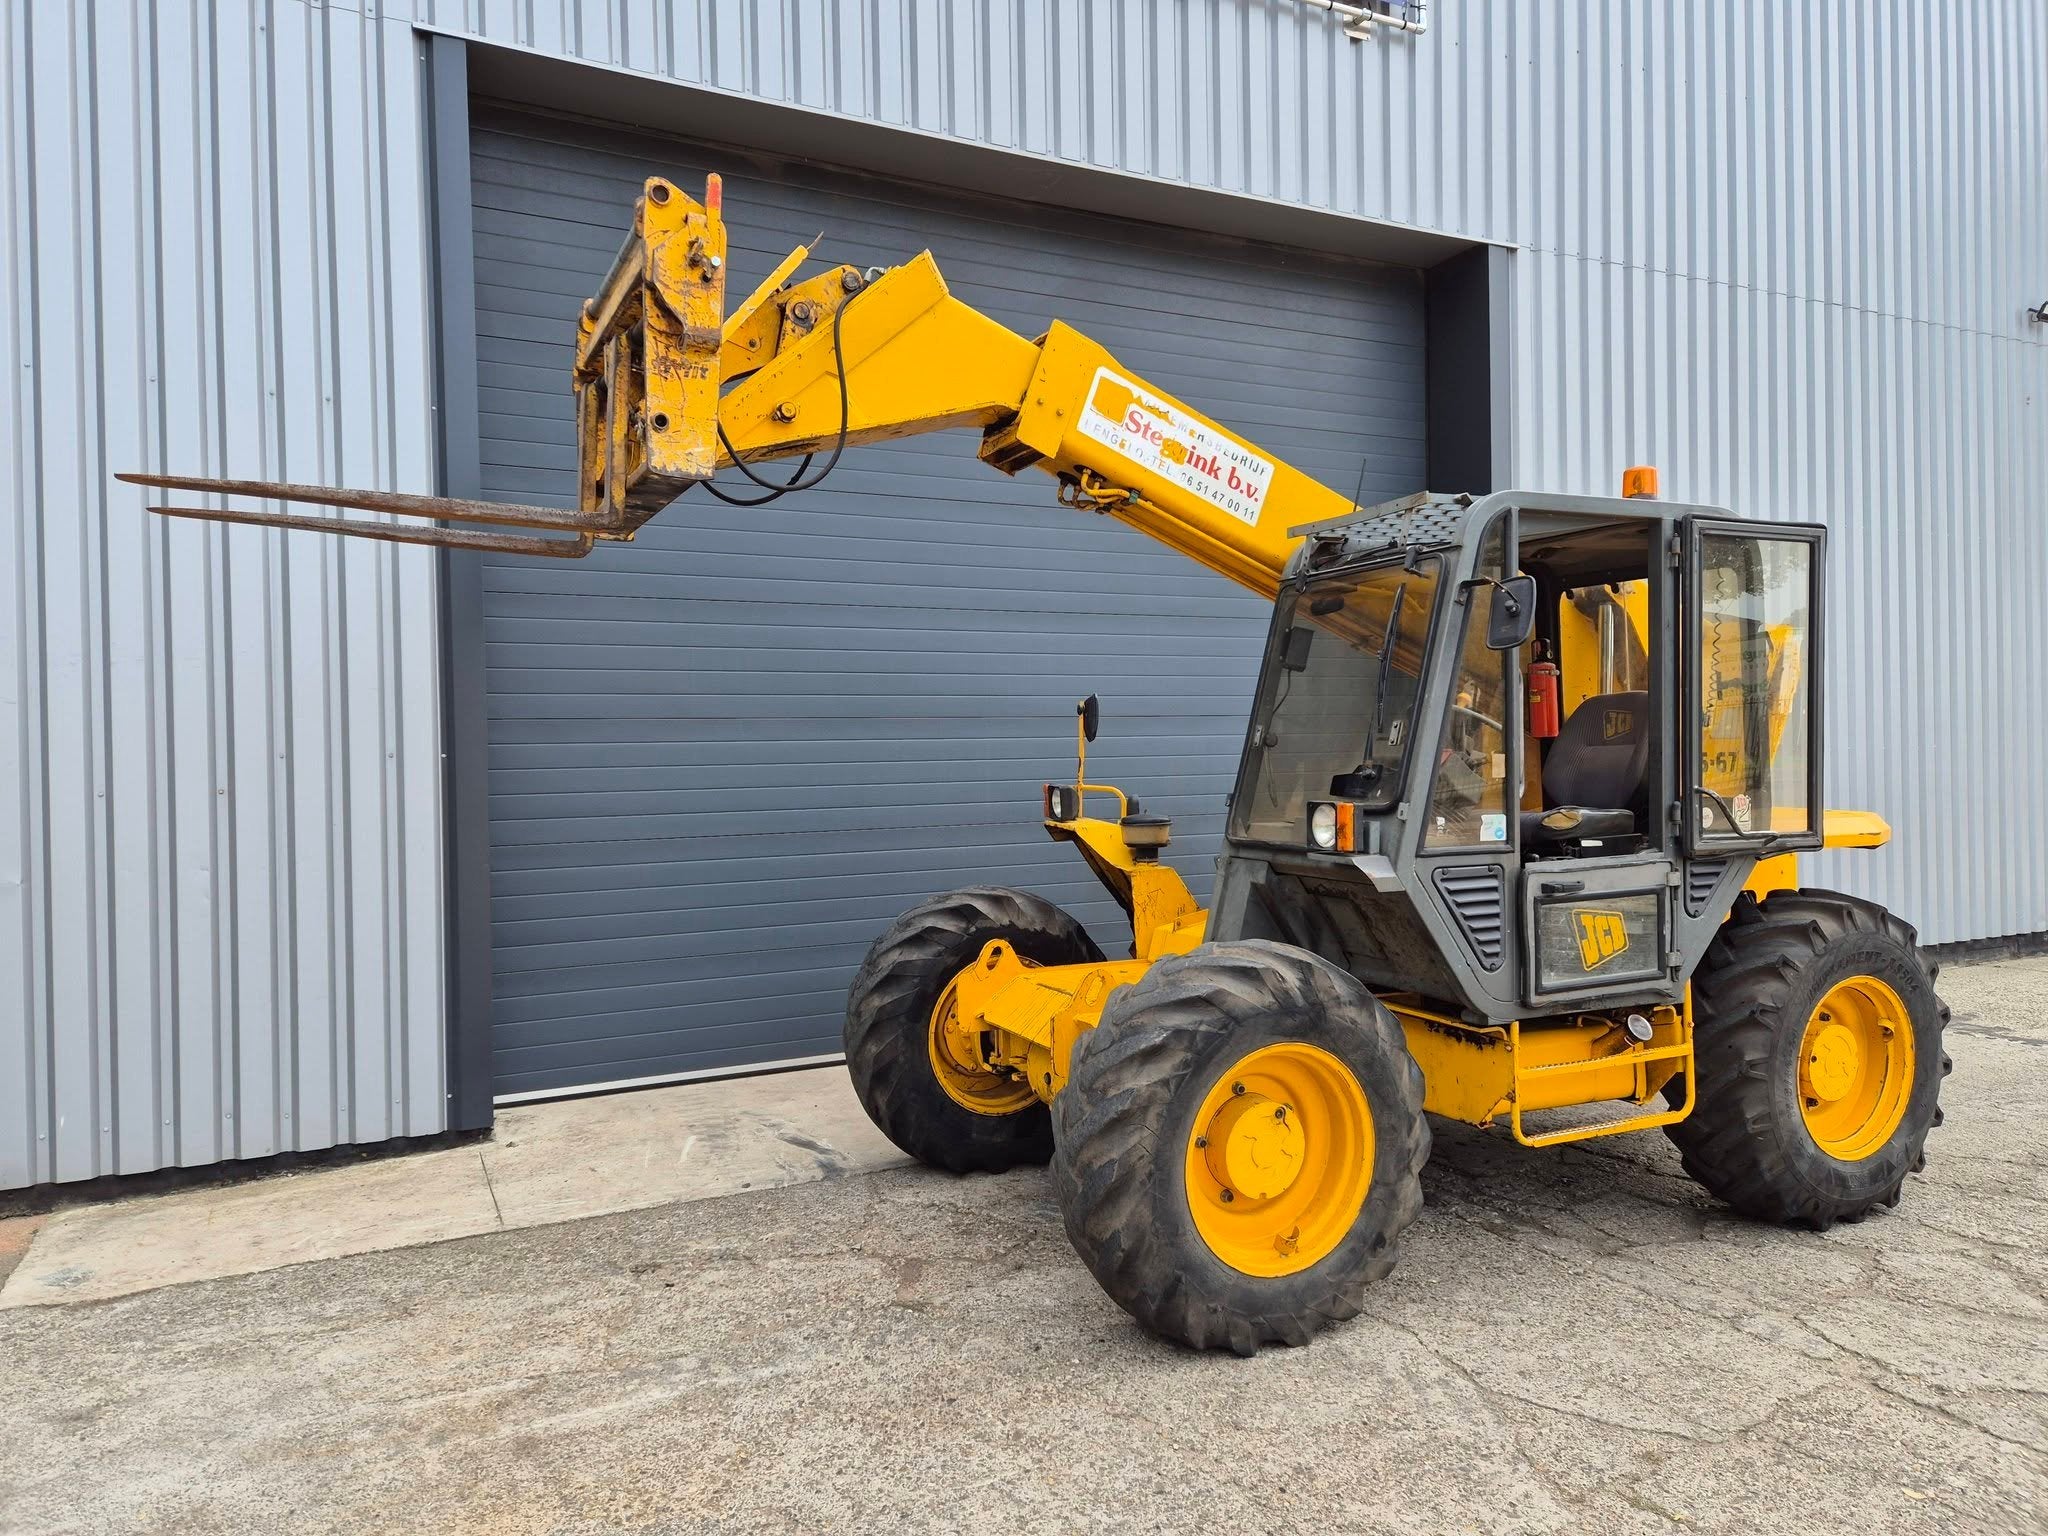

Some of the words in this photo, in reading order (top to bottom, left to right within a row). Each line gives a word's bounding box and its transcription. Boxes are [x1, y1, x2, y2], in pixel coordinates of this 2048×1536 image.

[1196, 481, 1209, 496] 51
[1212, 490, 1226, 504] 47
[1227, 498, 1240, 513] 00
[1243, 507, 1256, 521] 11
[1227, 465, 1259, 503] b.v.
[1580, 914, 1626, 967] JCB
